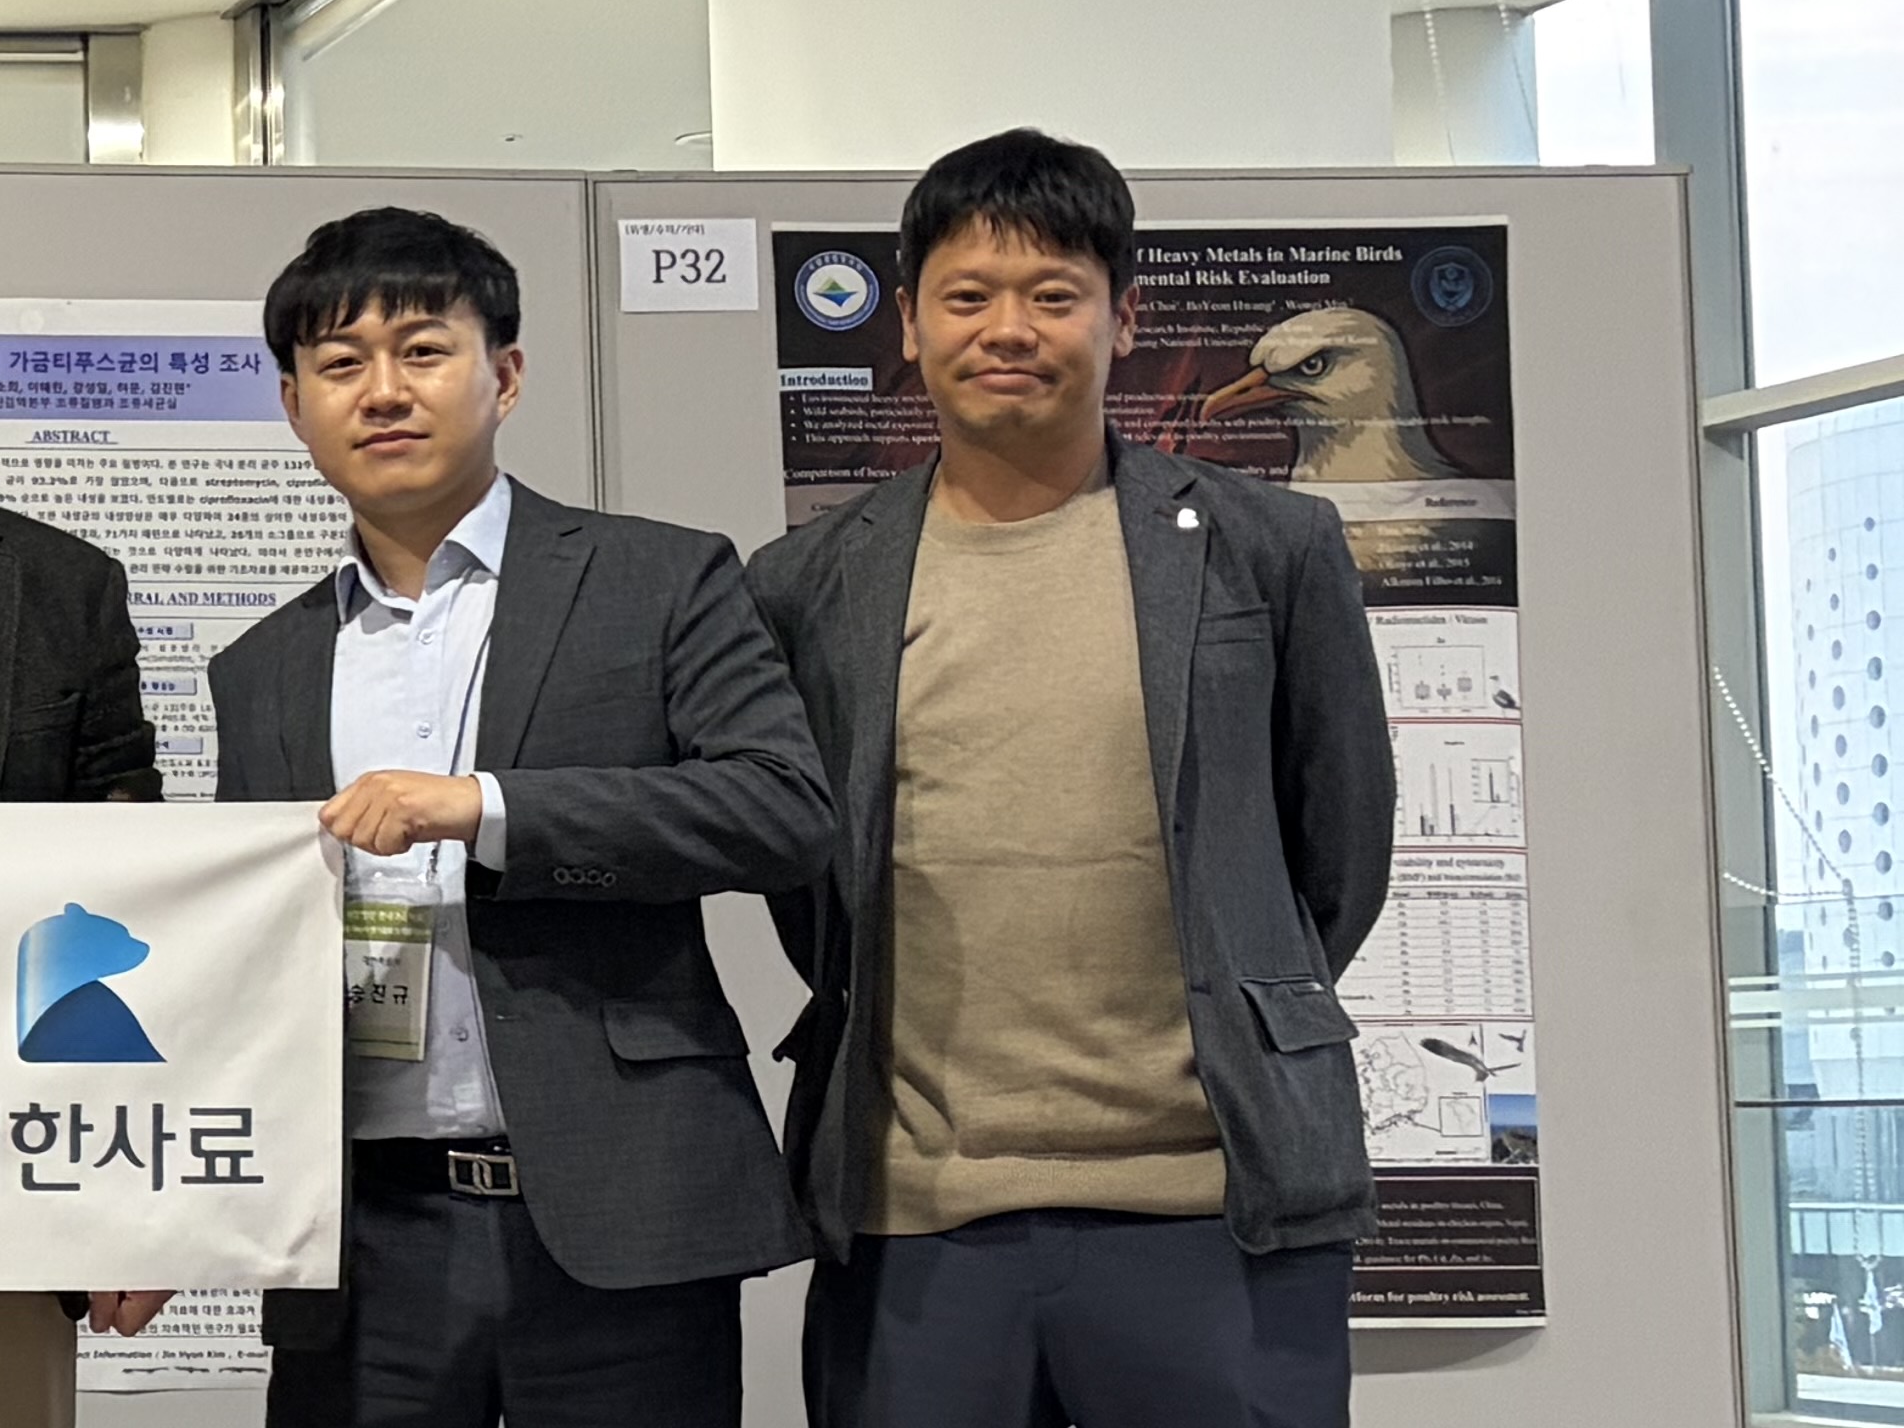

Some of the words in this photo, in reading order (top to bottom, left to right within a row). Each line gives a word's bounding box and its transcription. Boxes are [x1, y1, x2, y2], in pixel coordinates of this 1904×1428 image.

[1148, 248, 1200, 266] Heavy
[1206, 247, 1263, 263] Metals
[1266, 247, 1284, 262] in
[1289, 246, 1351, 262] Marine
[1355, 246, 1403, 262] Birds
[651, 248, 727, 284] P32
[1195, 269, 1234, 286] Risk
[1238, 269, 1331, 286] Evaluation
[9, 350, 159, 373] 가금티푸스균의
[168, 351, 211, 374] 특성
[219, 352, 262, 373] 조사
[780, 373, 869, 387] Introduction
[32, 429, 111, 444] ABSTRACT
[166, 592, 199, 606] AND
[202, 592, 277, 606] METHODS
